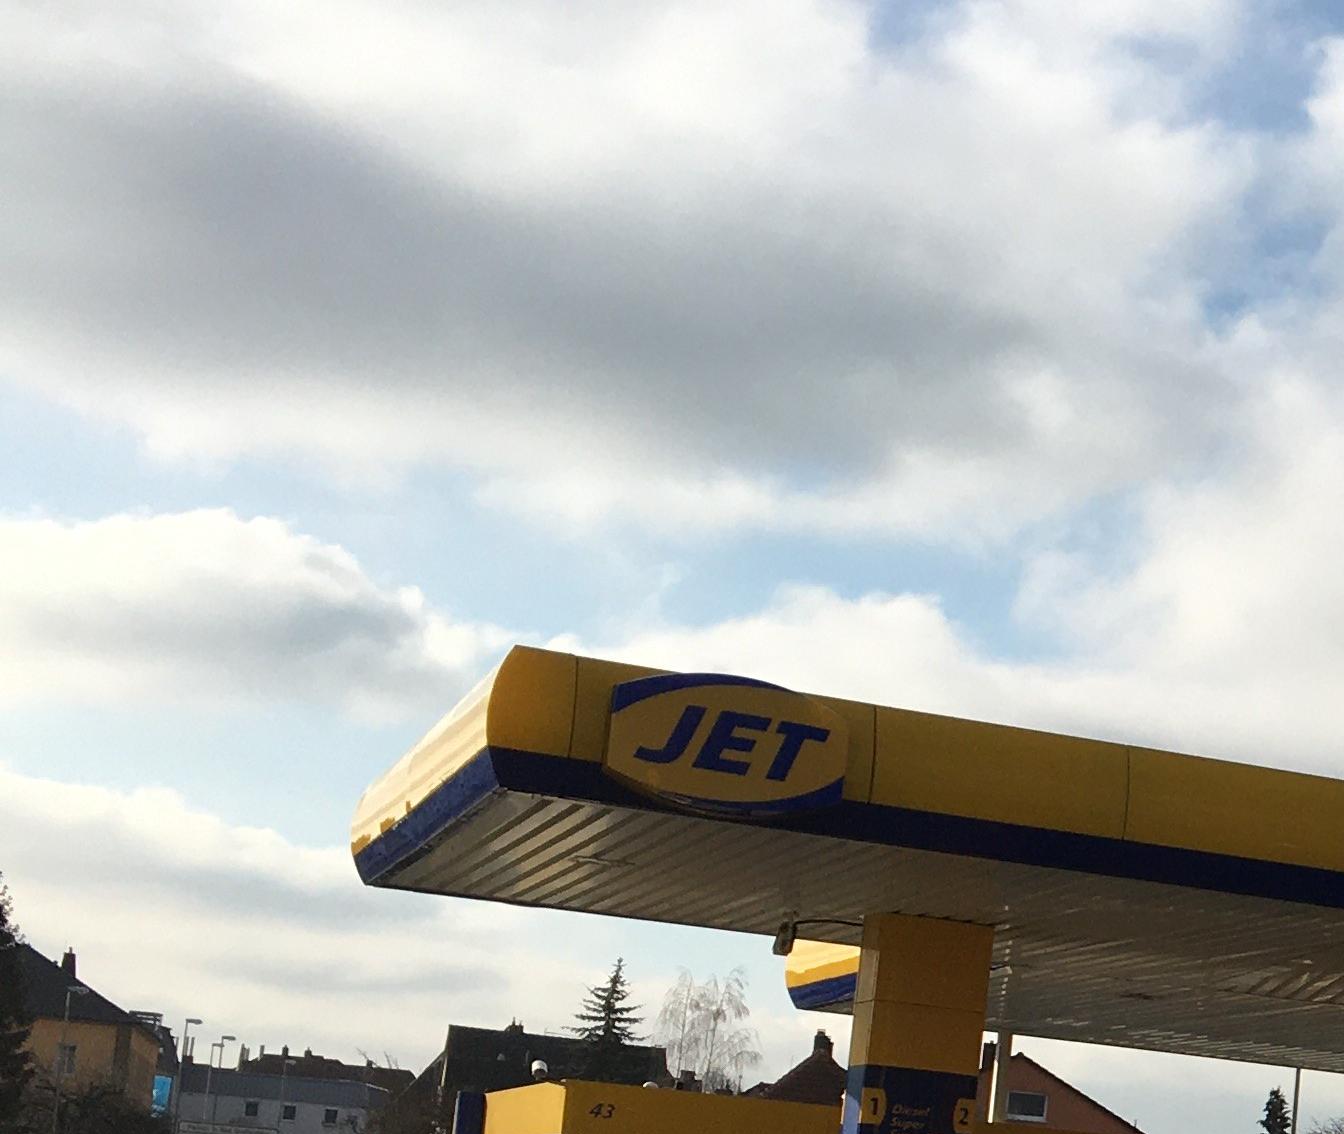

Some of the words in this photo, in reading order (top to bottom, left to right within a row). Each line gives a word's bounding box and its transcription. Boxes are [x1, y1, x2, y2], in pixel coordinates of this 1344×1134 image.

[632, 704, 831, 782] JET
[589, 1103, 616, 1119] 43
[870, 1097, 878, 1116] 1
[959, 1107, 969, 1126] 2
